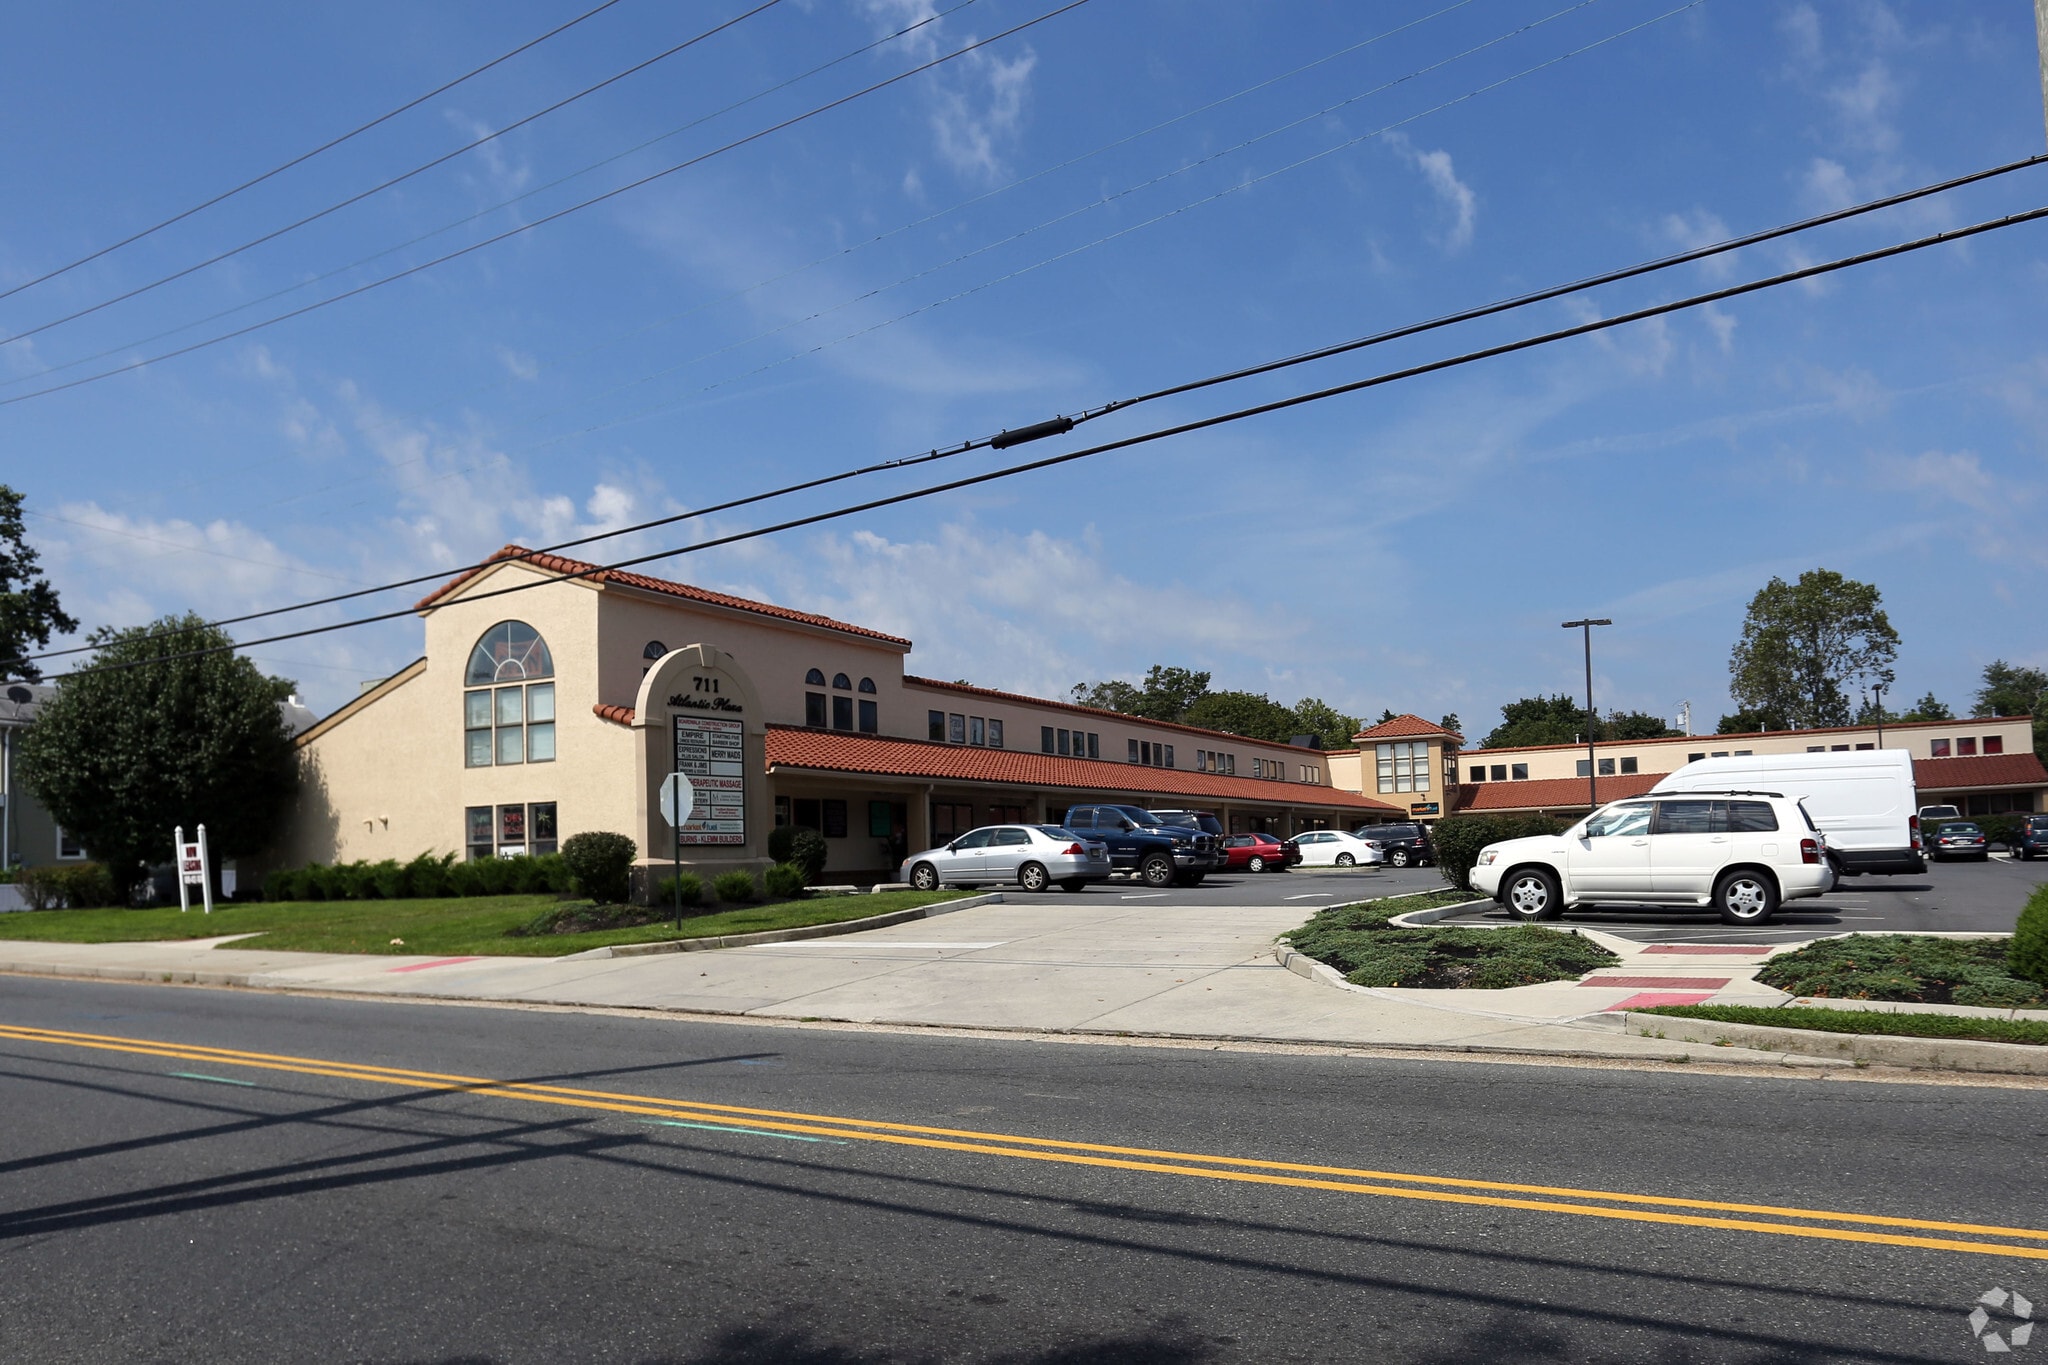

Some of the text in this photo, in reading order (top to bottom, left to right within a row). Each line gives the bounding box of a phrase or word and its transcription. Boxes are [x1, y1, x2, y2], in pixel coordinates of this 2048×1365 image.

[693, 677, 718, 693] 711
[667, 694, 743, 712] Atlantic Plaza
[702, 720, 728, 728] CONSTRUCTION
[682, 731, 704, 739] EMPIRE
[679, 746, 707, 754] EXPRESSIONS
[727, 751, 741, 759] MAIDS
[720, 779, 742, 788] MASSAGE
